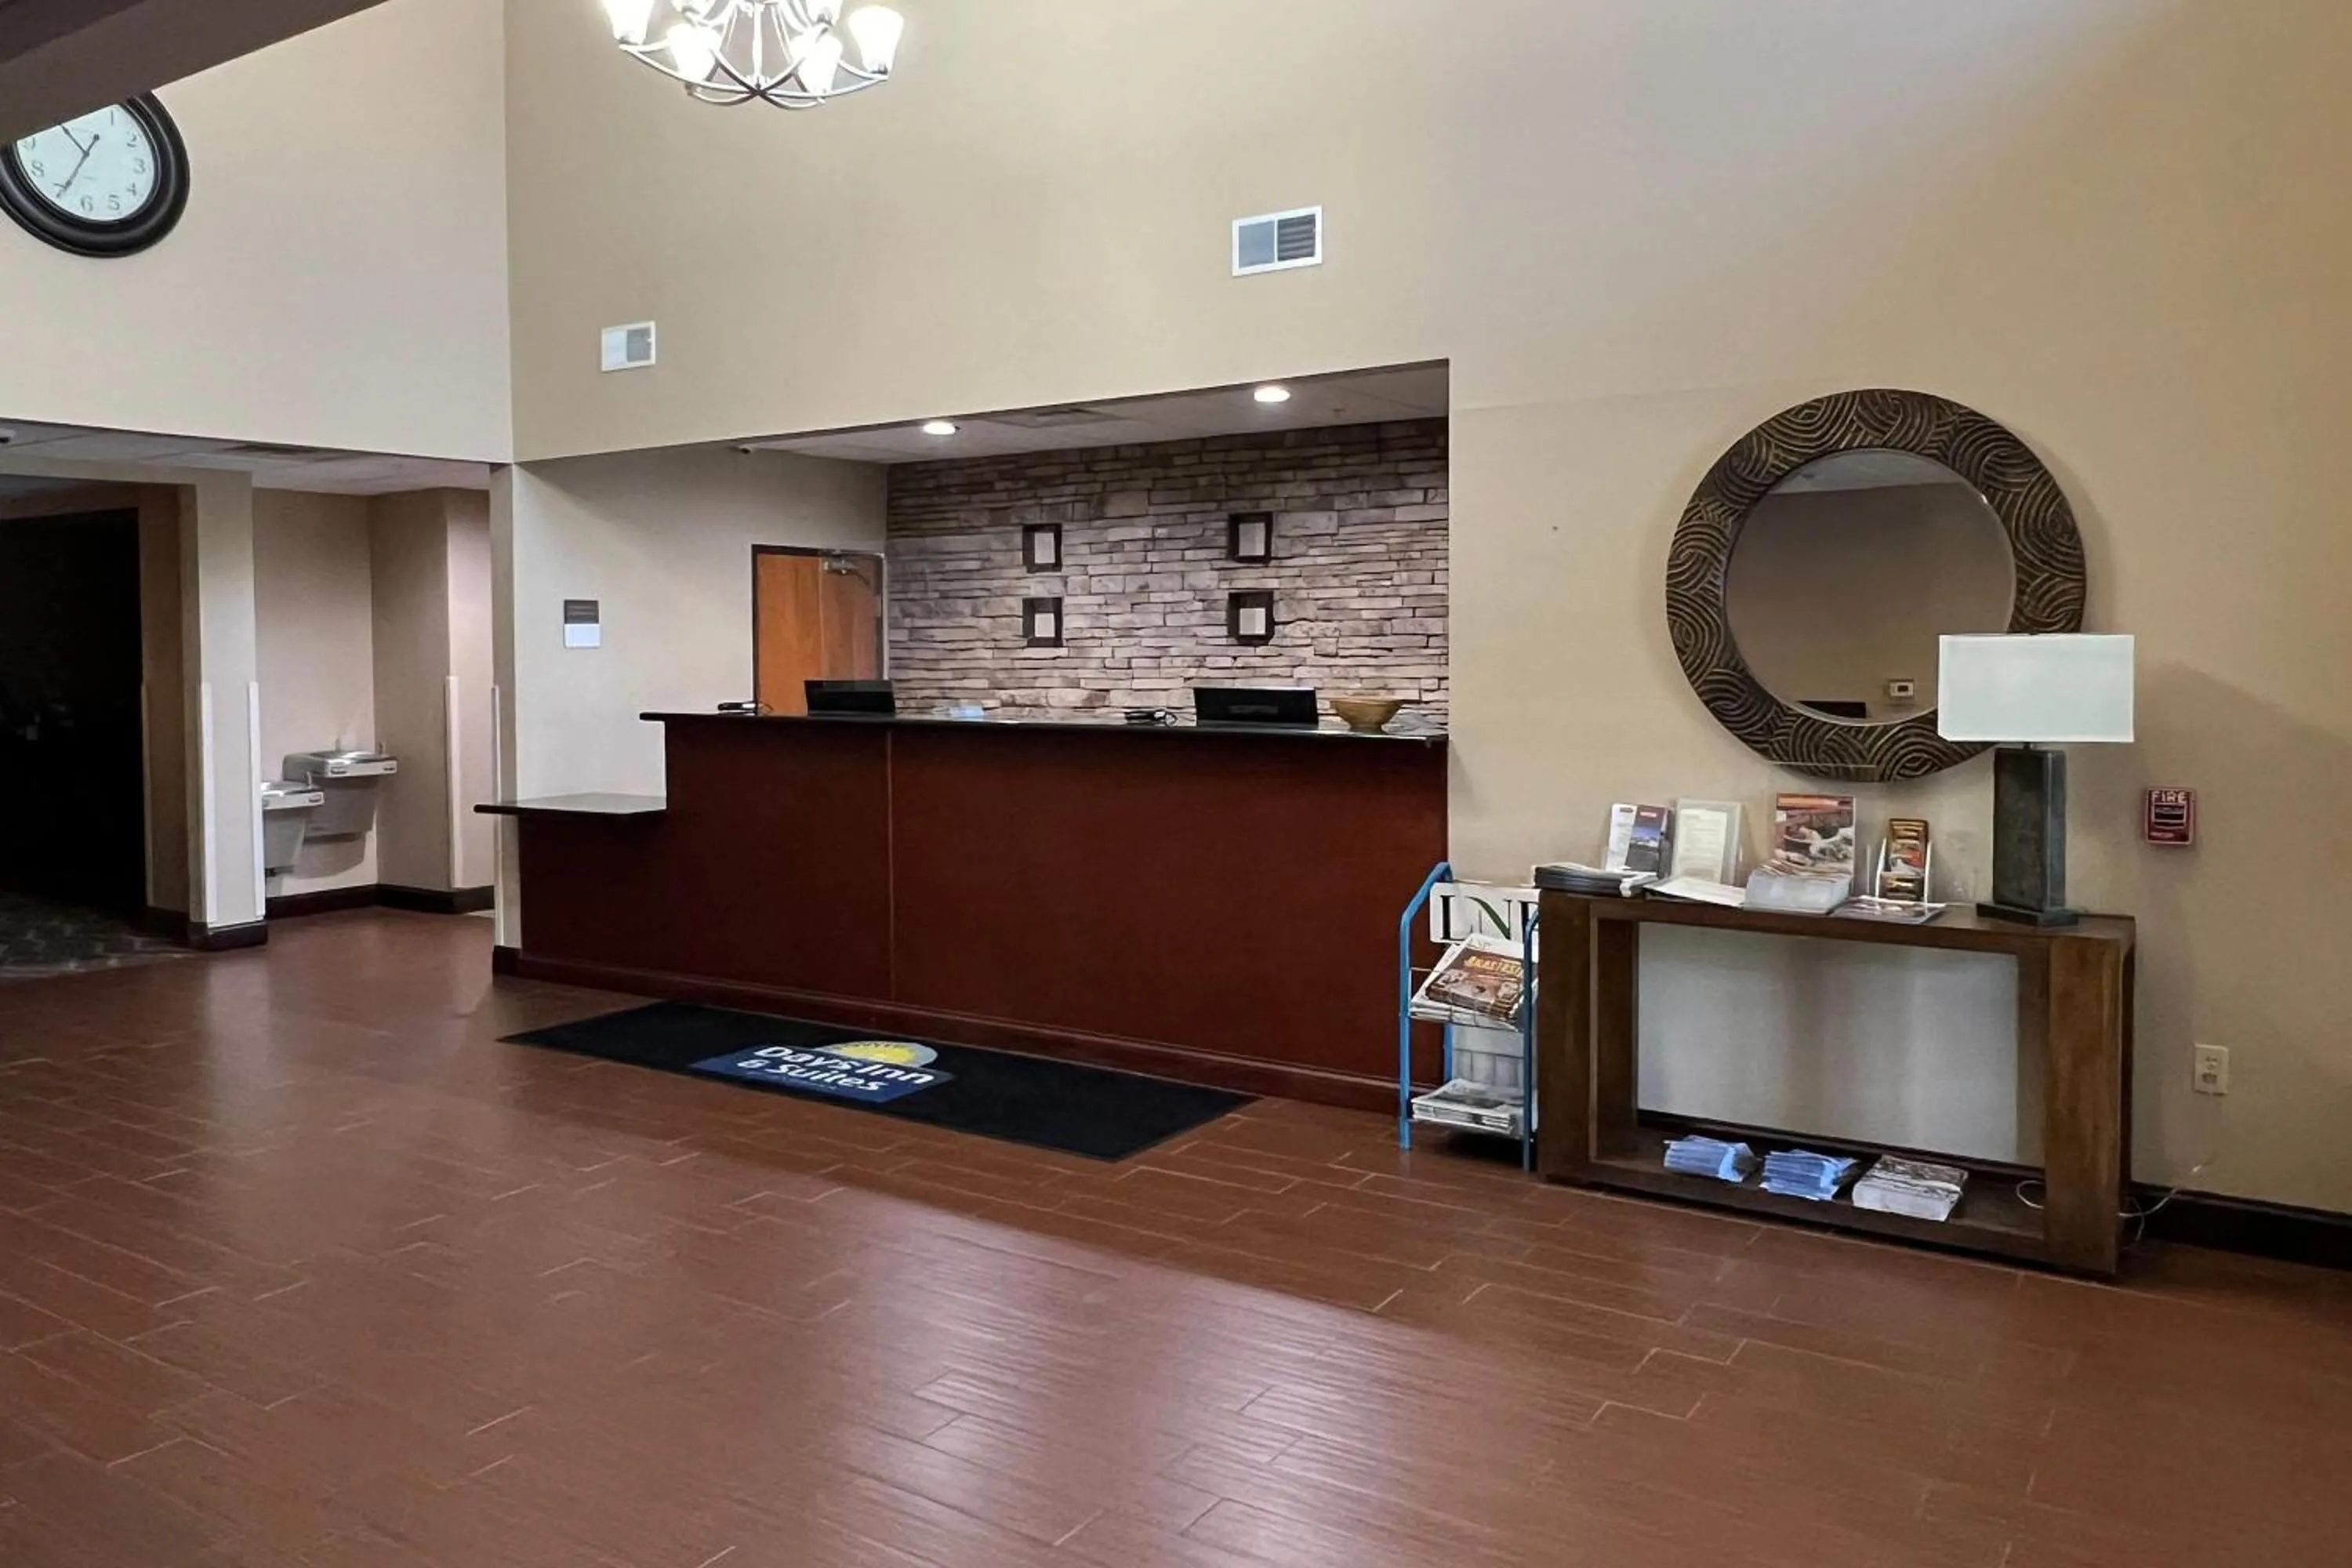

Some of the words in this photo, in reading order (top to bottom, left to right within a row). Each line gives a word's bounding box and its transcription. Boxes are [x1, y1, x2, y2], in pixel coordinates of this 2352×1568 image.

[125, 133, 138, 149] 2
[31, 159, 45, 178] 8
[132, 157, 147, 175] 3
[126, 181, 137, 197] 4
[81, 194, 94, 212] 6
[106, 194, 120, 211] 5
[2151, 790, 2187, 804] FIRE
[753, 1046, 862, 1070] Days
[855, 1064, 935, 1084] Inn
[764, 1064, 889, 1091] Suites
